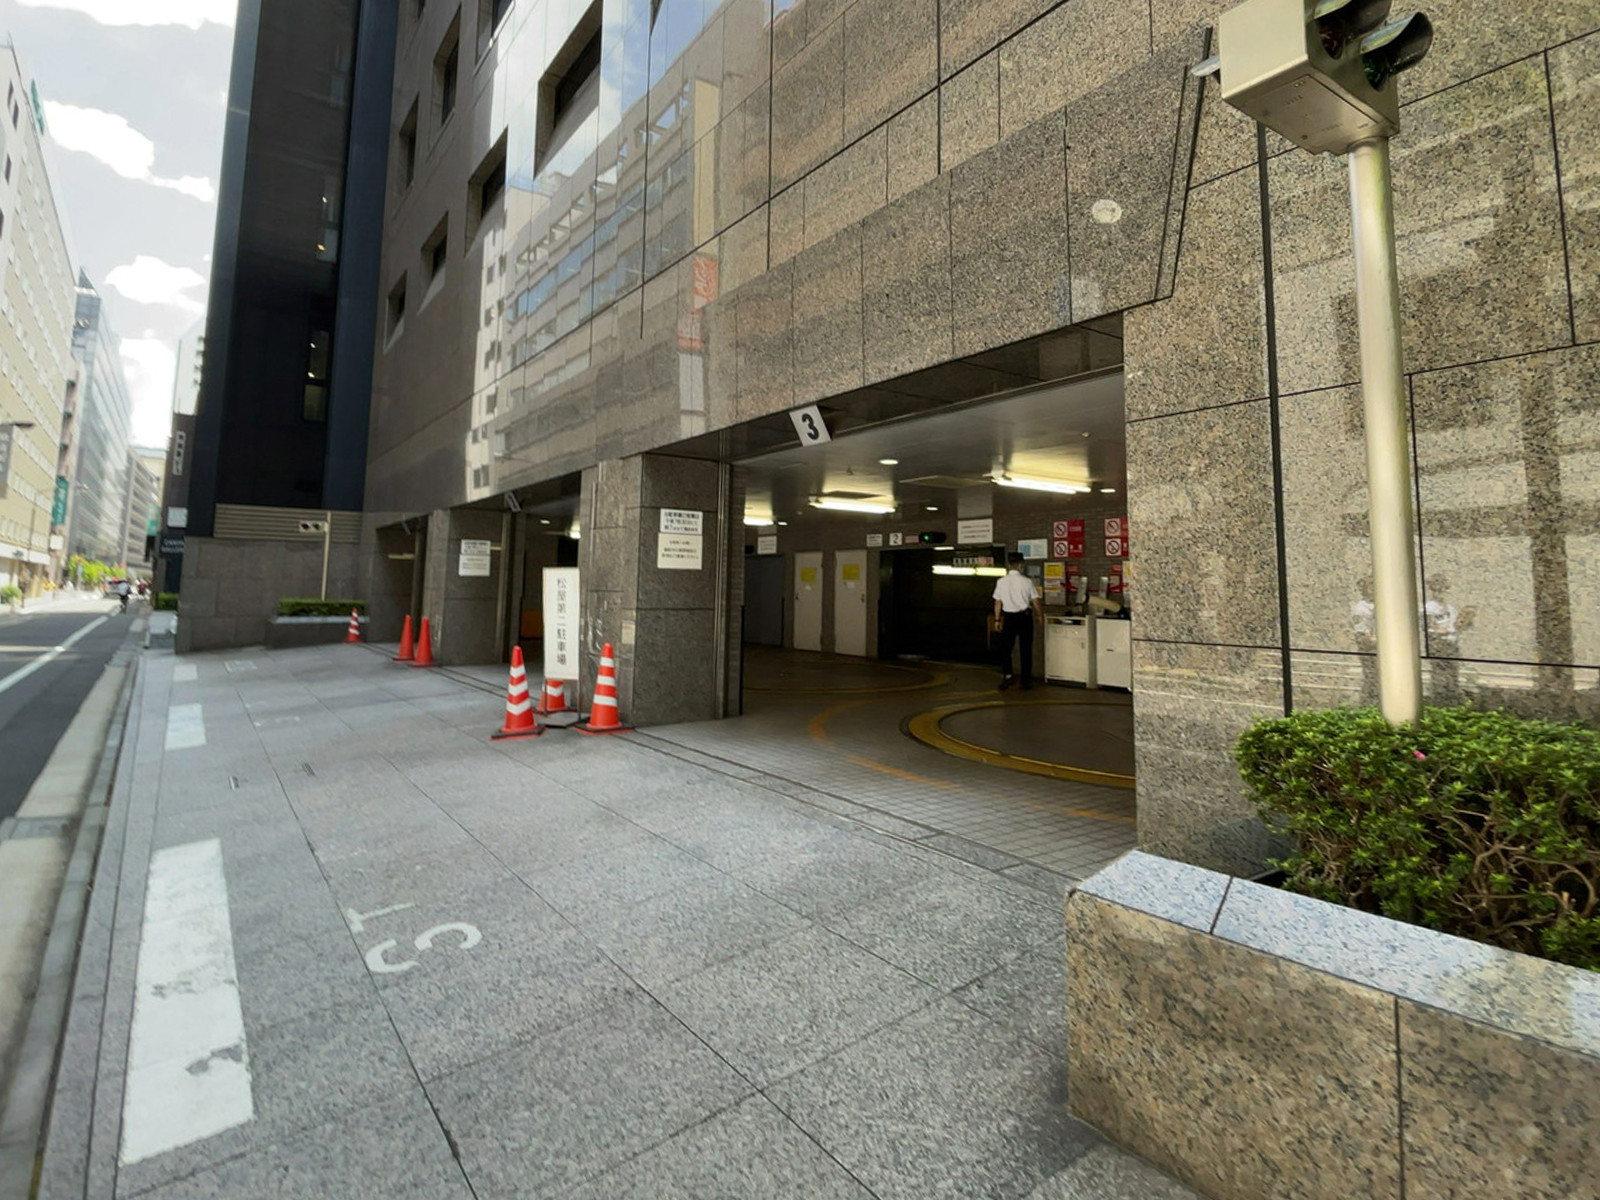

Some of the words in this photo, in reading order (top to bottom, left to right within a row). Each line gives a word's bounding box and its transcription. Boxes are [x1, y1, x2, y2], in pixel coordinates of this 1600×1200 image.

[802, 413, 819, 440] 3
[556, 577, 567, 665] 松屋第二駐車場
